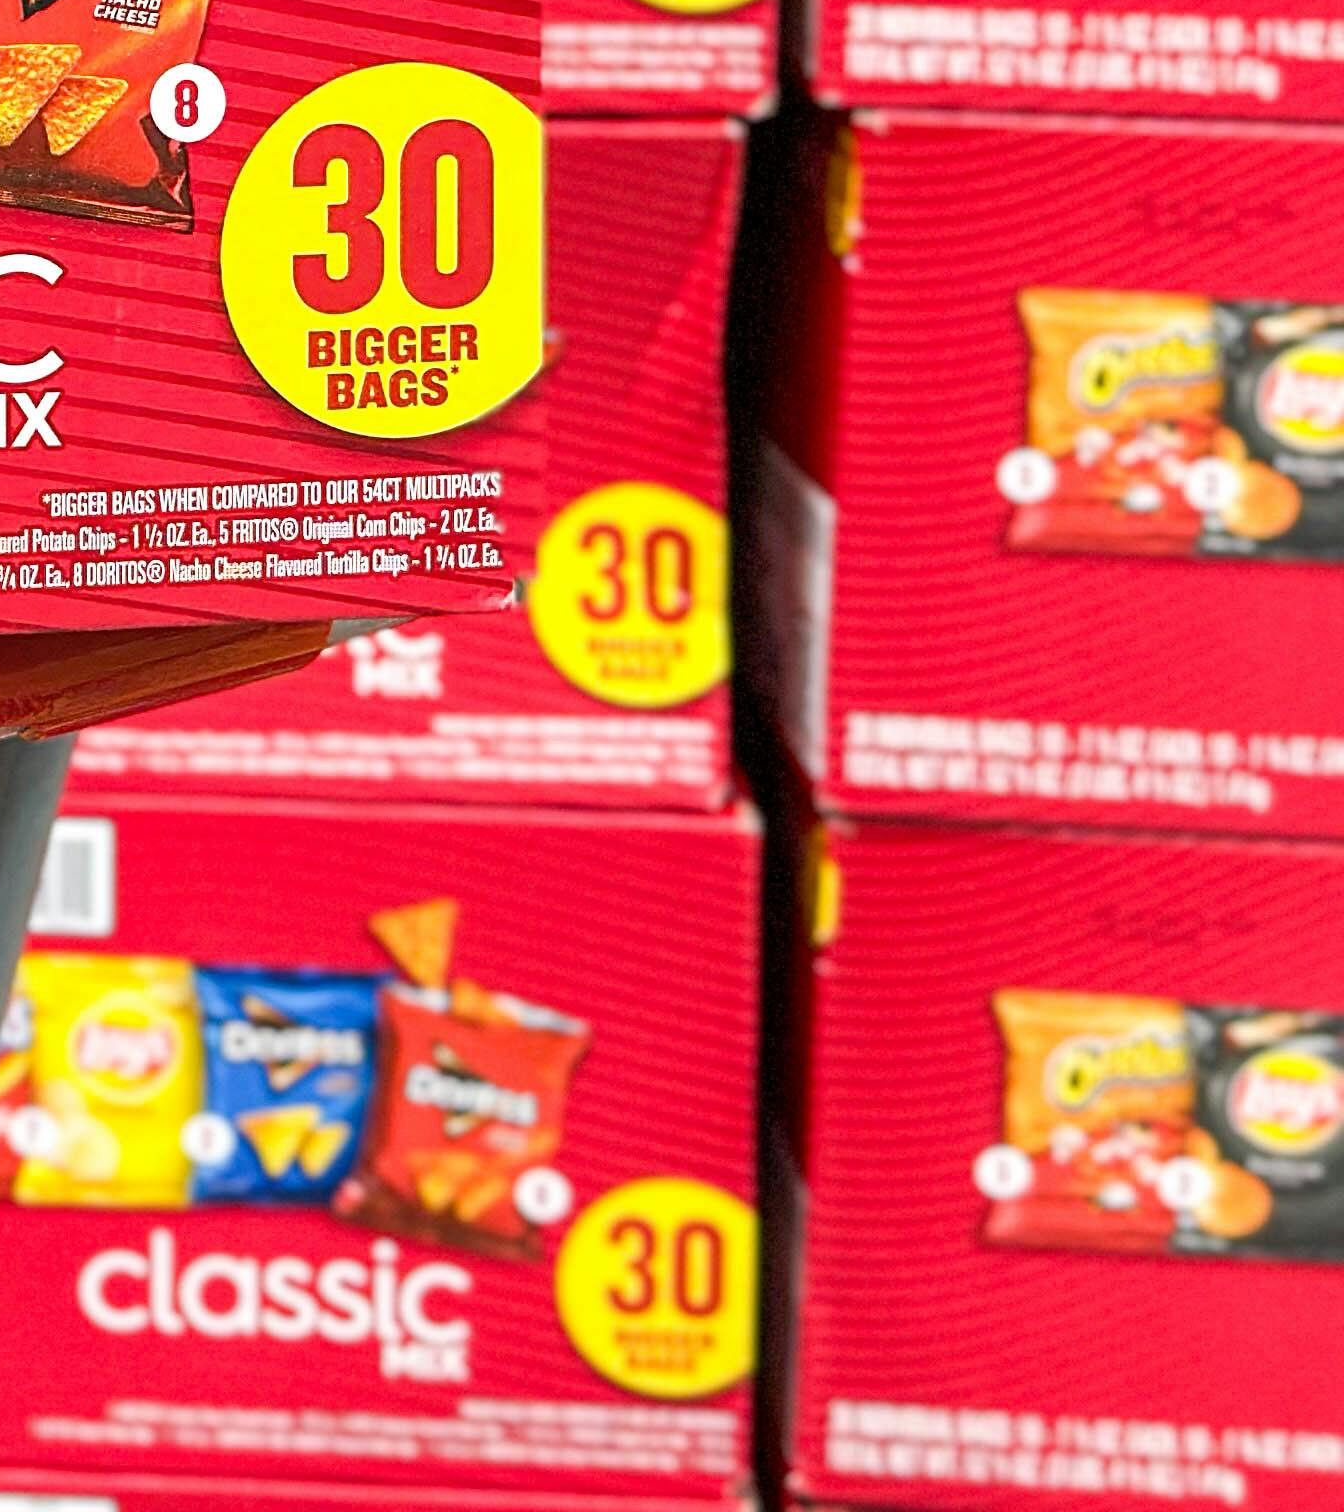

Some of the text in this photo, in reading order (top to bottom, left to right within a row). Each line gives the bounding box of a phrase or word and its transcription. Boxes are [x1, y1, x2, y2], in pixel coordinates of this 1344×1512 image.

[93, 5, 160, 26] CHEESE
[174, 79, 199, 127] 8
[291, 119, 495, 314] 30
[307, 329, 480, 369] BIGGER
[112, 490, 155, 515] BAGS
[159, 487, 207, 512] WHEN
[212, 483, 297, 509] COMPARED
[301, 482, 321, 505] TO
[326, 480, 358, 504] OUR
[363, 477, 402, 502] 54CT
[406, 472, 501, 500] MULTIPACKS
[33, 529, 75, 552] Potato
[80, 527, 115, 555] Chips
[303, 515, 353, 544] Original
[357, 514, 386, 537] Corn
[390, 512, 425, 540] Chips
[170, 558, 211, 582] Nacho
[215, 557, 262, 580] Cheese
[266, 552, 322, 577] Flavored
[325, 550, 369, 574] Tortilla
[373, 549, 408, 576] Chips
[483, 543, 502, 566] Ea.
[579, 525, 693, 624] 30
[78, 1229, 471, 1343] classic
[607, 1219, 724, 1317] 30
